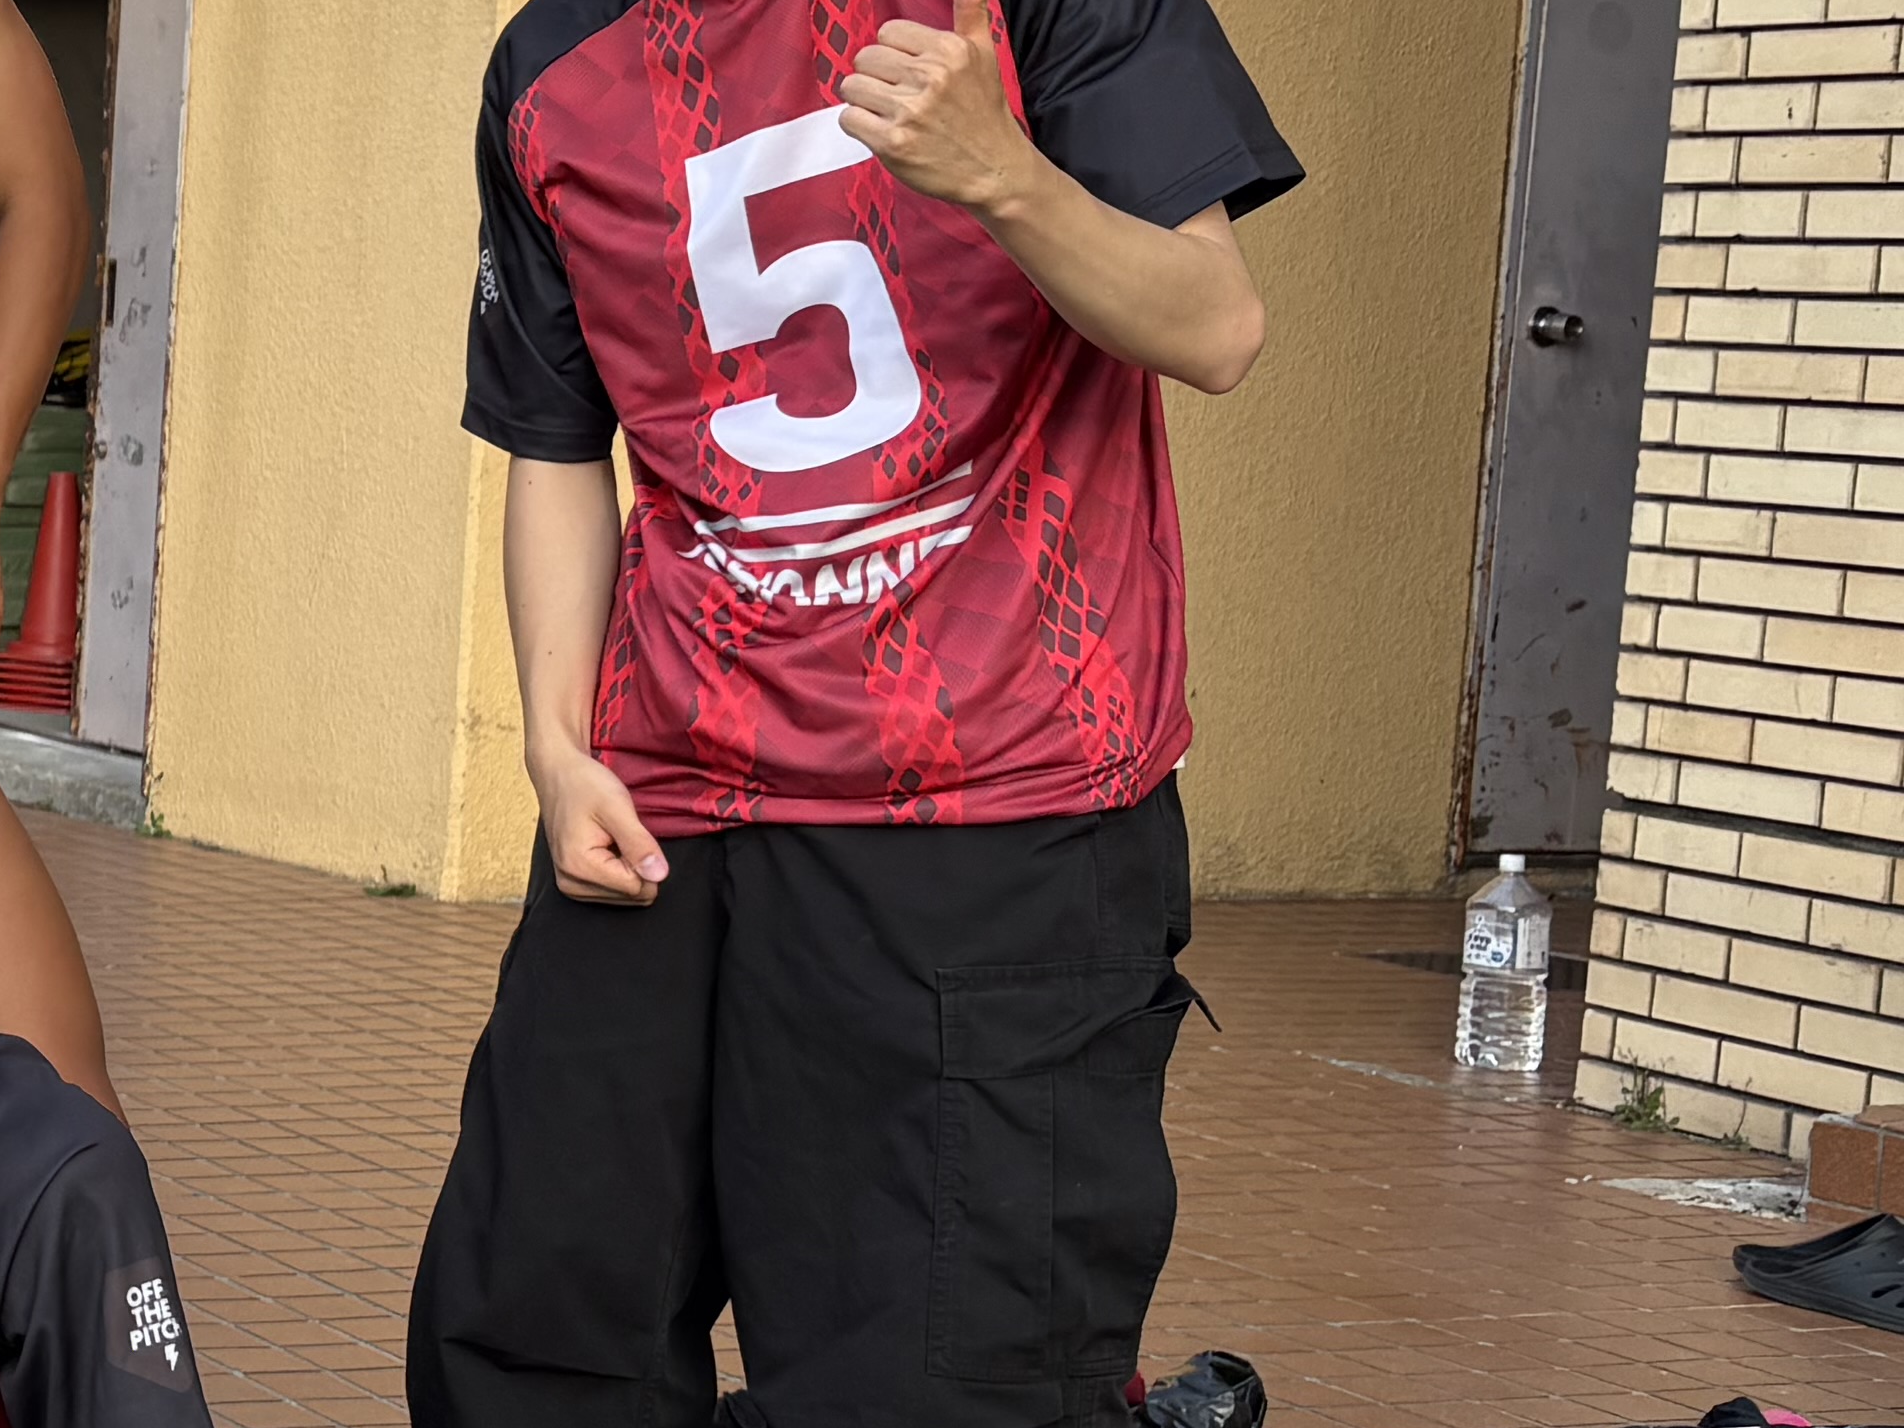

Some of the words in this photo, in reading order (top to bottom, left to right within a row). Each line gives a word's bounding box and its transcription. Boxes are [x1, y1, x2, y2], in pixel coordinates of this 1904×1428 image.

[684, 103, 921, 473] 5
[126, 1278, 164, 1308] OFF
[130, 1297, 172, 1328] THE
